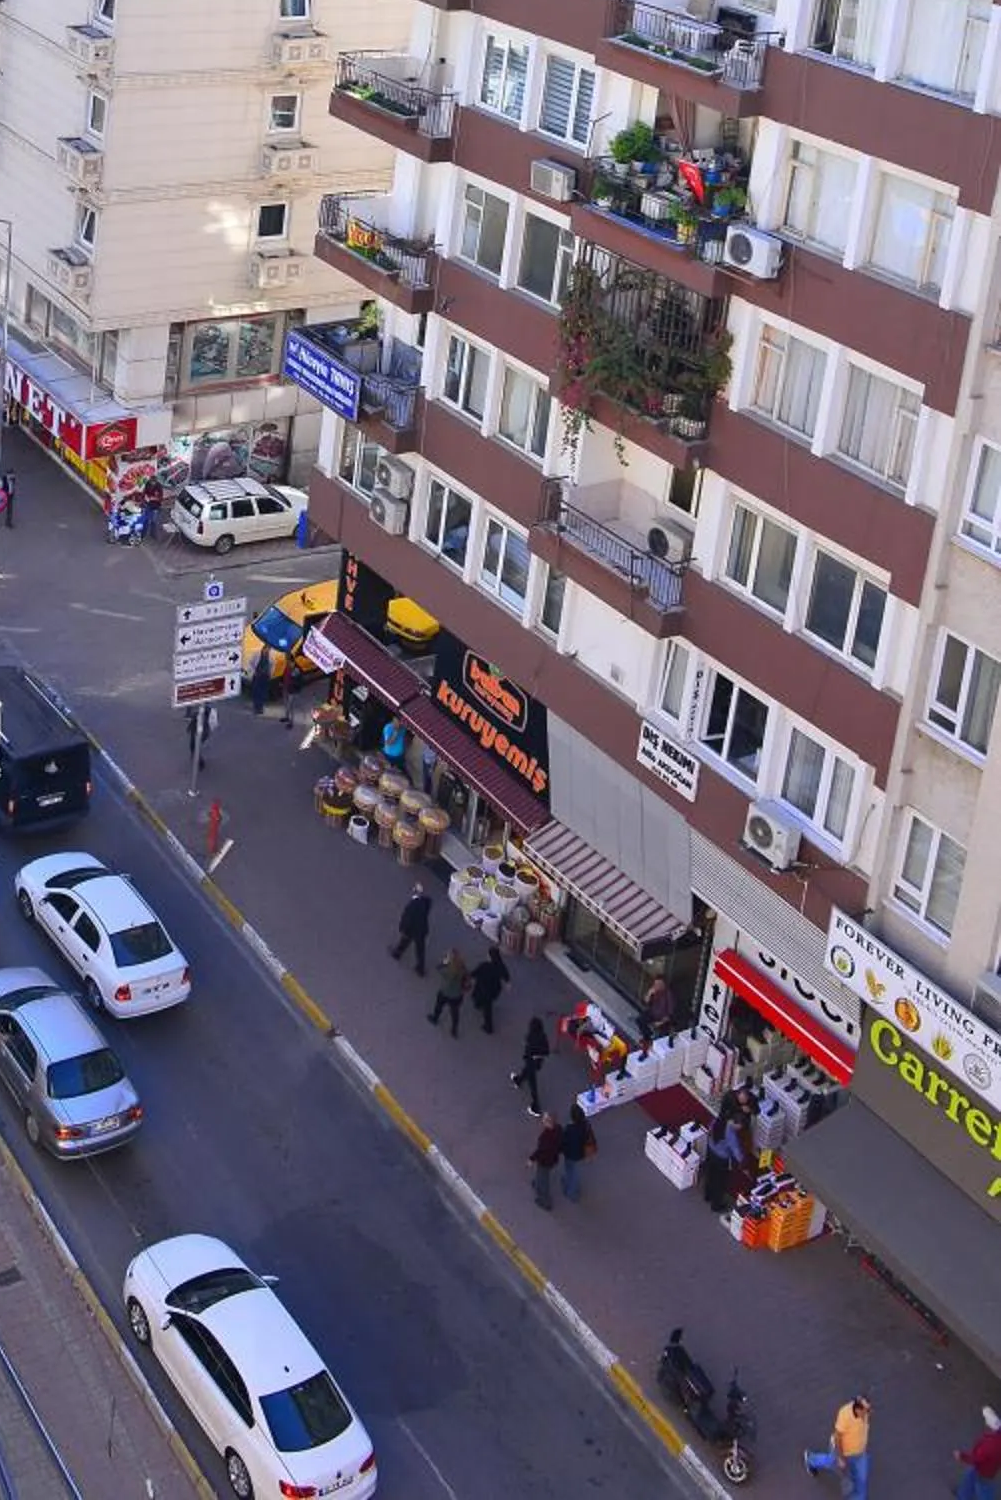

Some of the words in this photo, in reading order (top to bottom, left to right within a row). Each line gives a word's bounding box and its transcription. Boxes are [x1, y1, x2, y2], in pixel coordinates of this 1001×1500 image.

[437, 679, 548, 793] kuruyemiş
[835, 915, 905, 980] FOREVER
[915, 979, 976, 1035] LIVING
